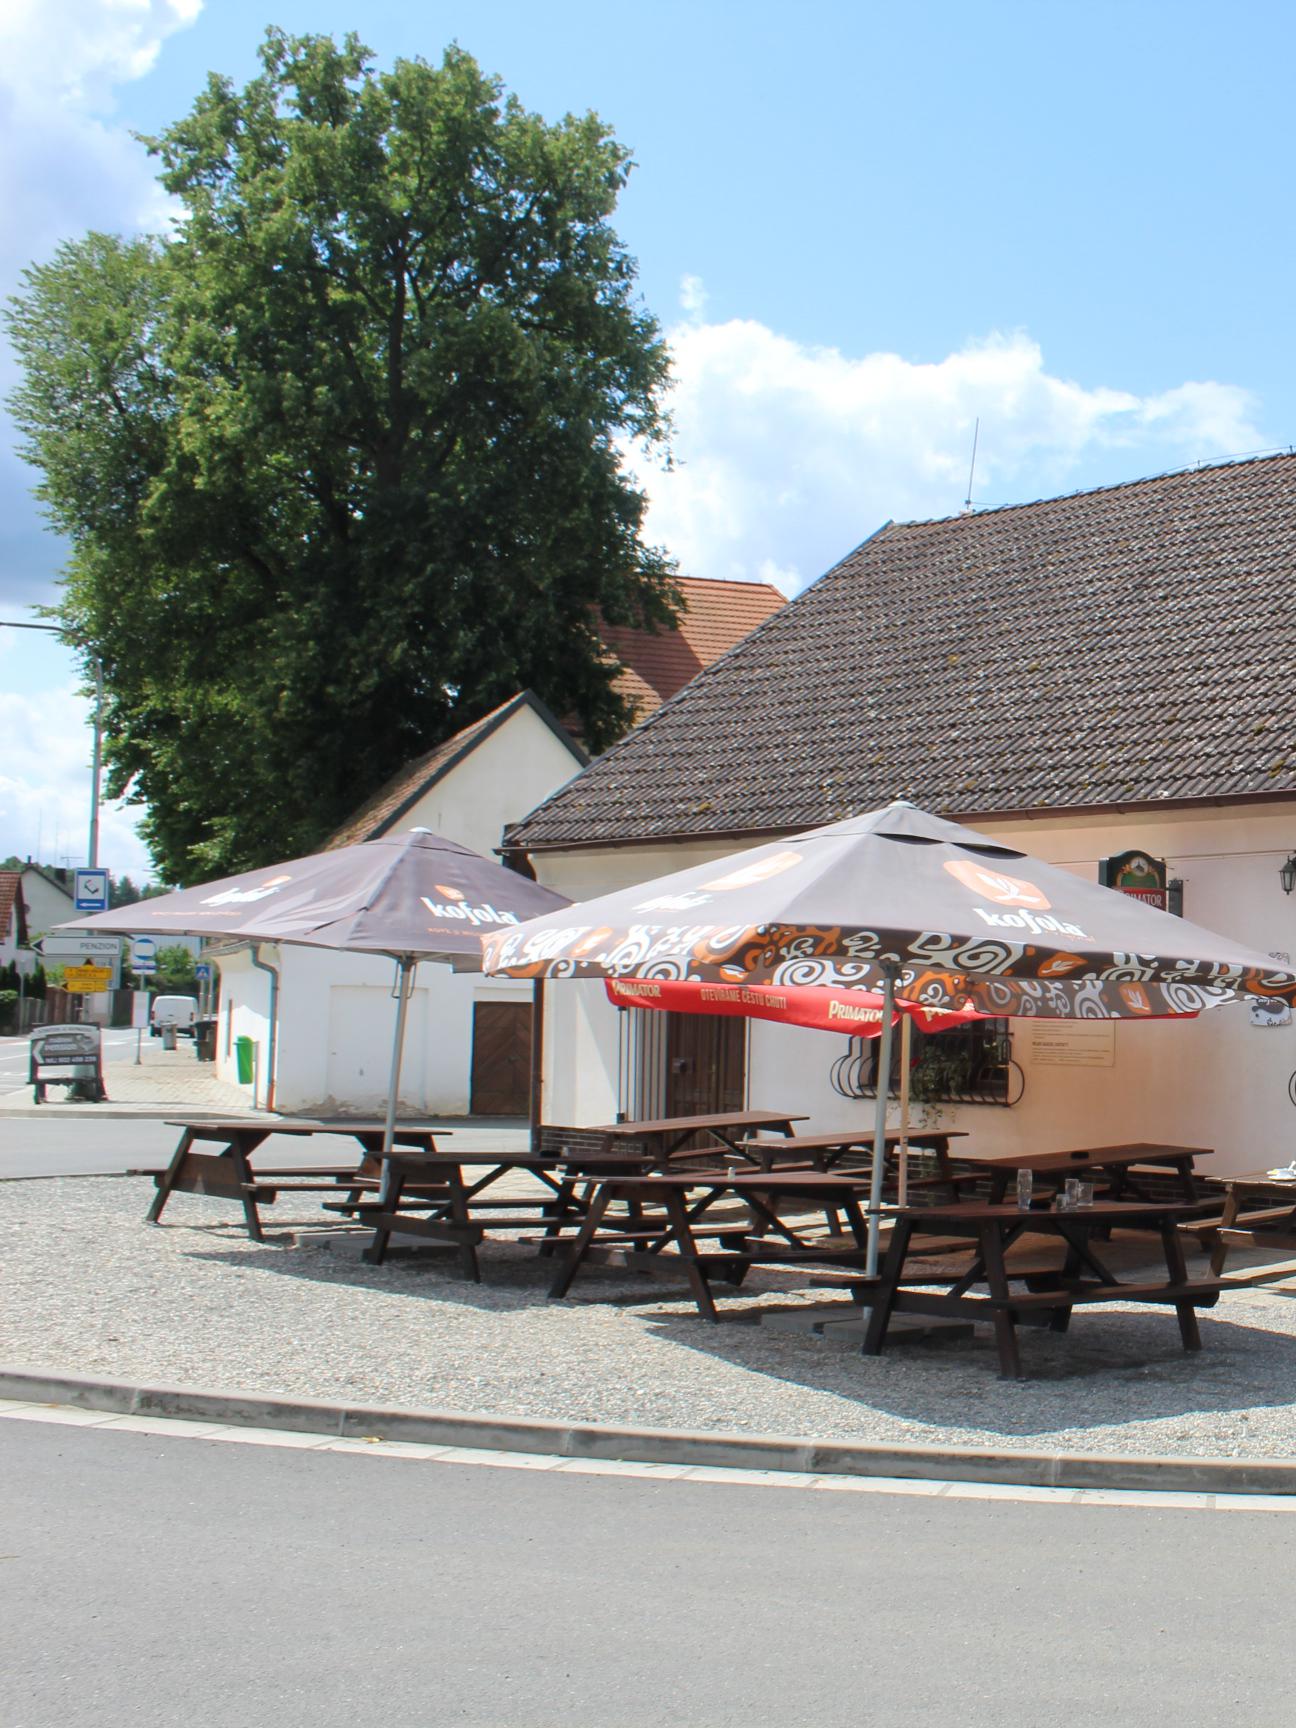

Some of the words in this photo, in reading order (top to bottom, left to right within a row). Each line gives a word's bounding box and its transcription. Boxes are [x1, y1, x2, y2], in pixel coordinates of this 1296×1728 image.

[420, 896, 520, 926] kofola
[972, 906, 1088, 938] kofola
[80, 942, 118, 950] PENZION
[612, 980, 662, 998] PRIMATOR
